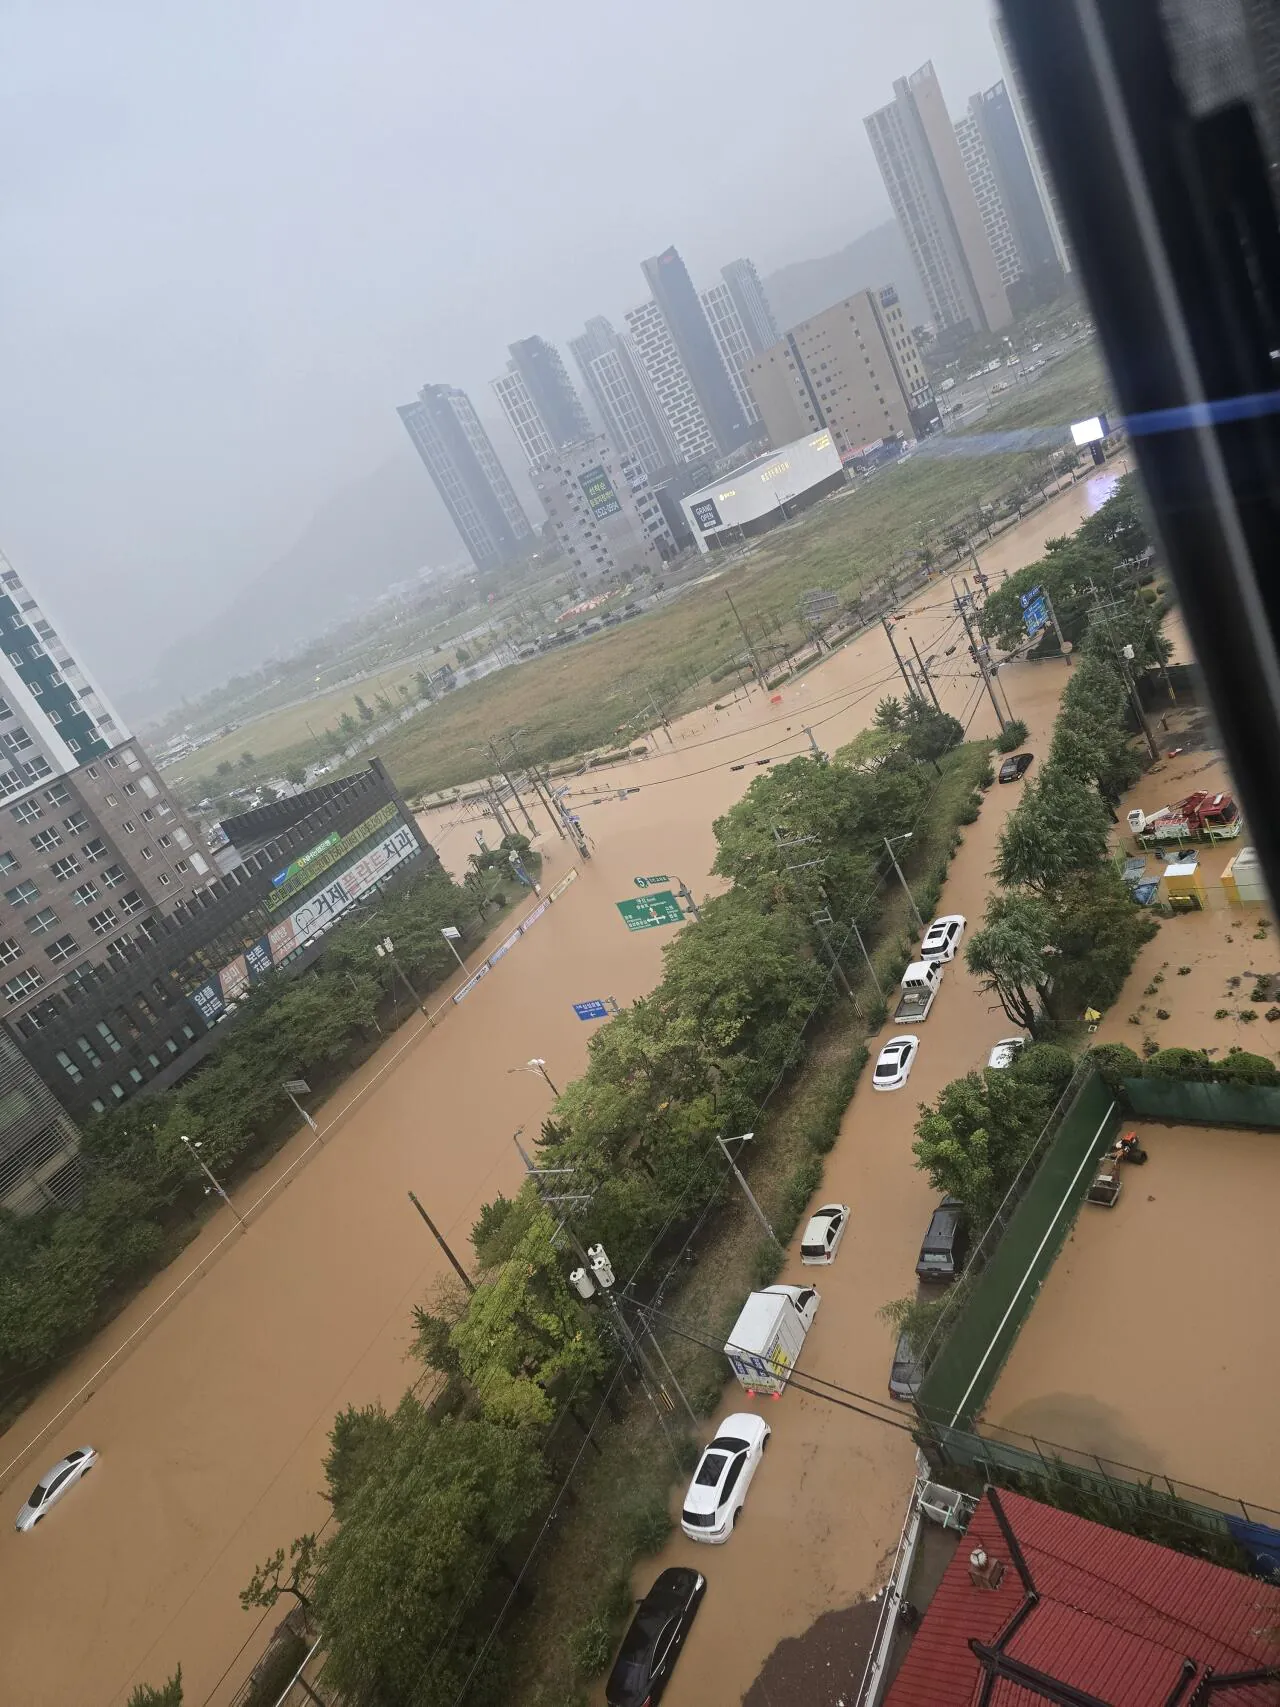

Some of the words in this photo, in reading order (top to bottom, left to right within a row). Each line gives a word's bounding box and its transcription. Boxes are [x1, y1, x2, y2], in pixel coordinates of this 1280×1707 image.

[695, 504, 713, 516] GRAND
[700, 512, 714, 522] OPEN
[636, 877, 645, 887] 5
[246, 944, 265, 964] 보존
[253, 955, 272, 973] 치료
[194, 985, 215, 1006] 임플
[201, 996, 223, 1017] 란트
